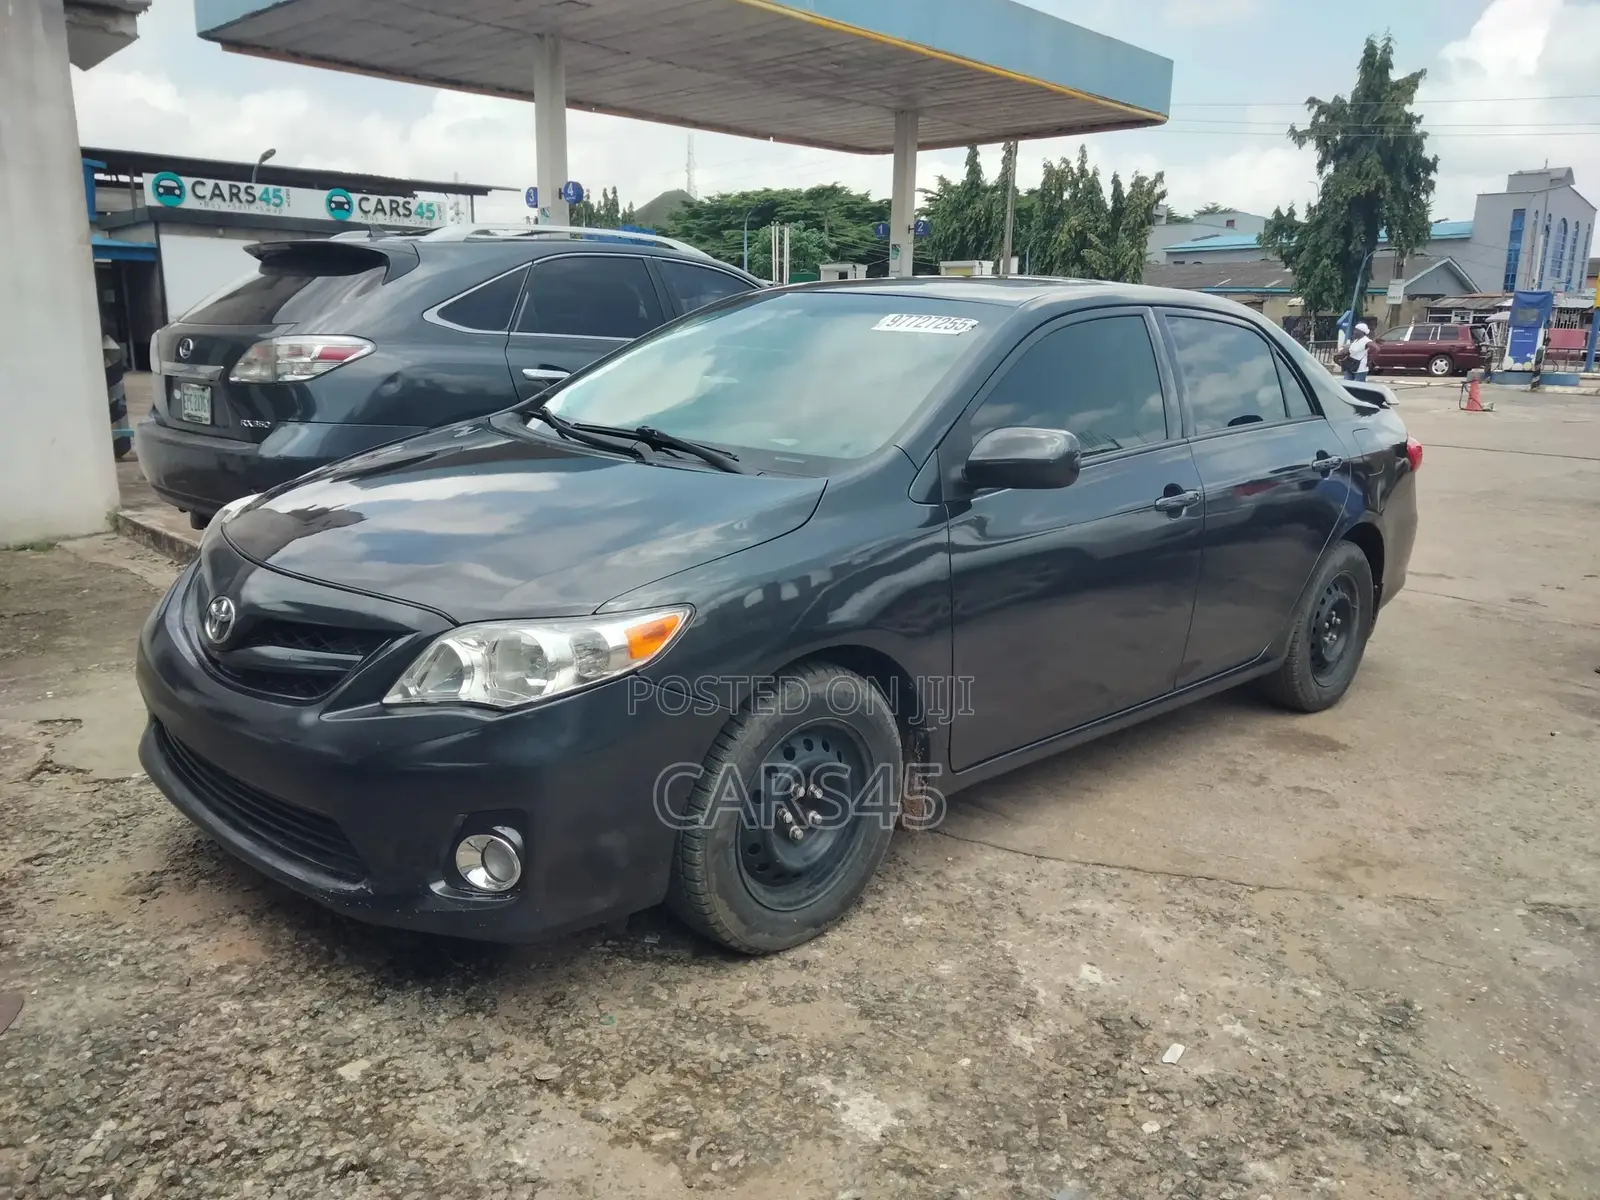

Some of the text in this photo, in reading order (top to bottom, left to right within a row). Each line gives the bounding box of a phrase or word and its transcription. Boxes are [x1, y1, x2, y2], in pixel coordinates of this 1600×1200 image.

[191, 180, 284, 208] CARS45
[529, 188, 535, 202] 3
[567, 182, 574, 196] 4
[358, 196, 436, 221] CARS45
[878, 224, 883, 234] 1
[917, 221, 924, 232] 2
[886, 314, 972, 331] 97727255
